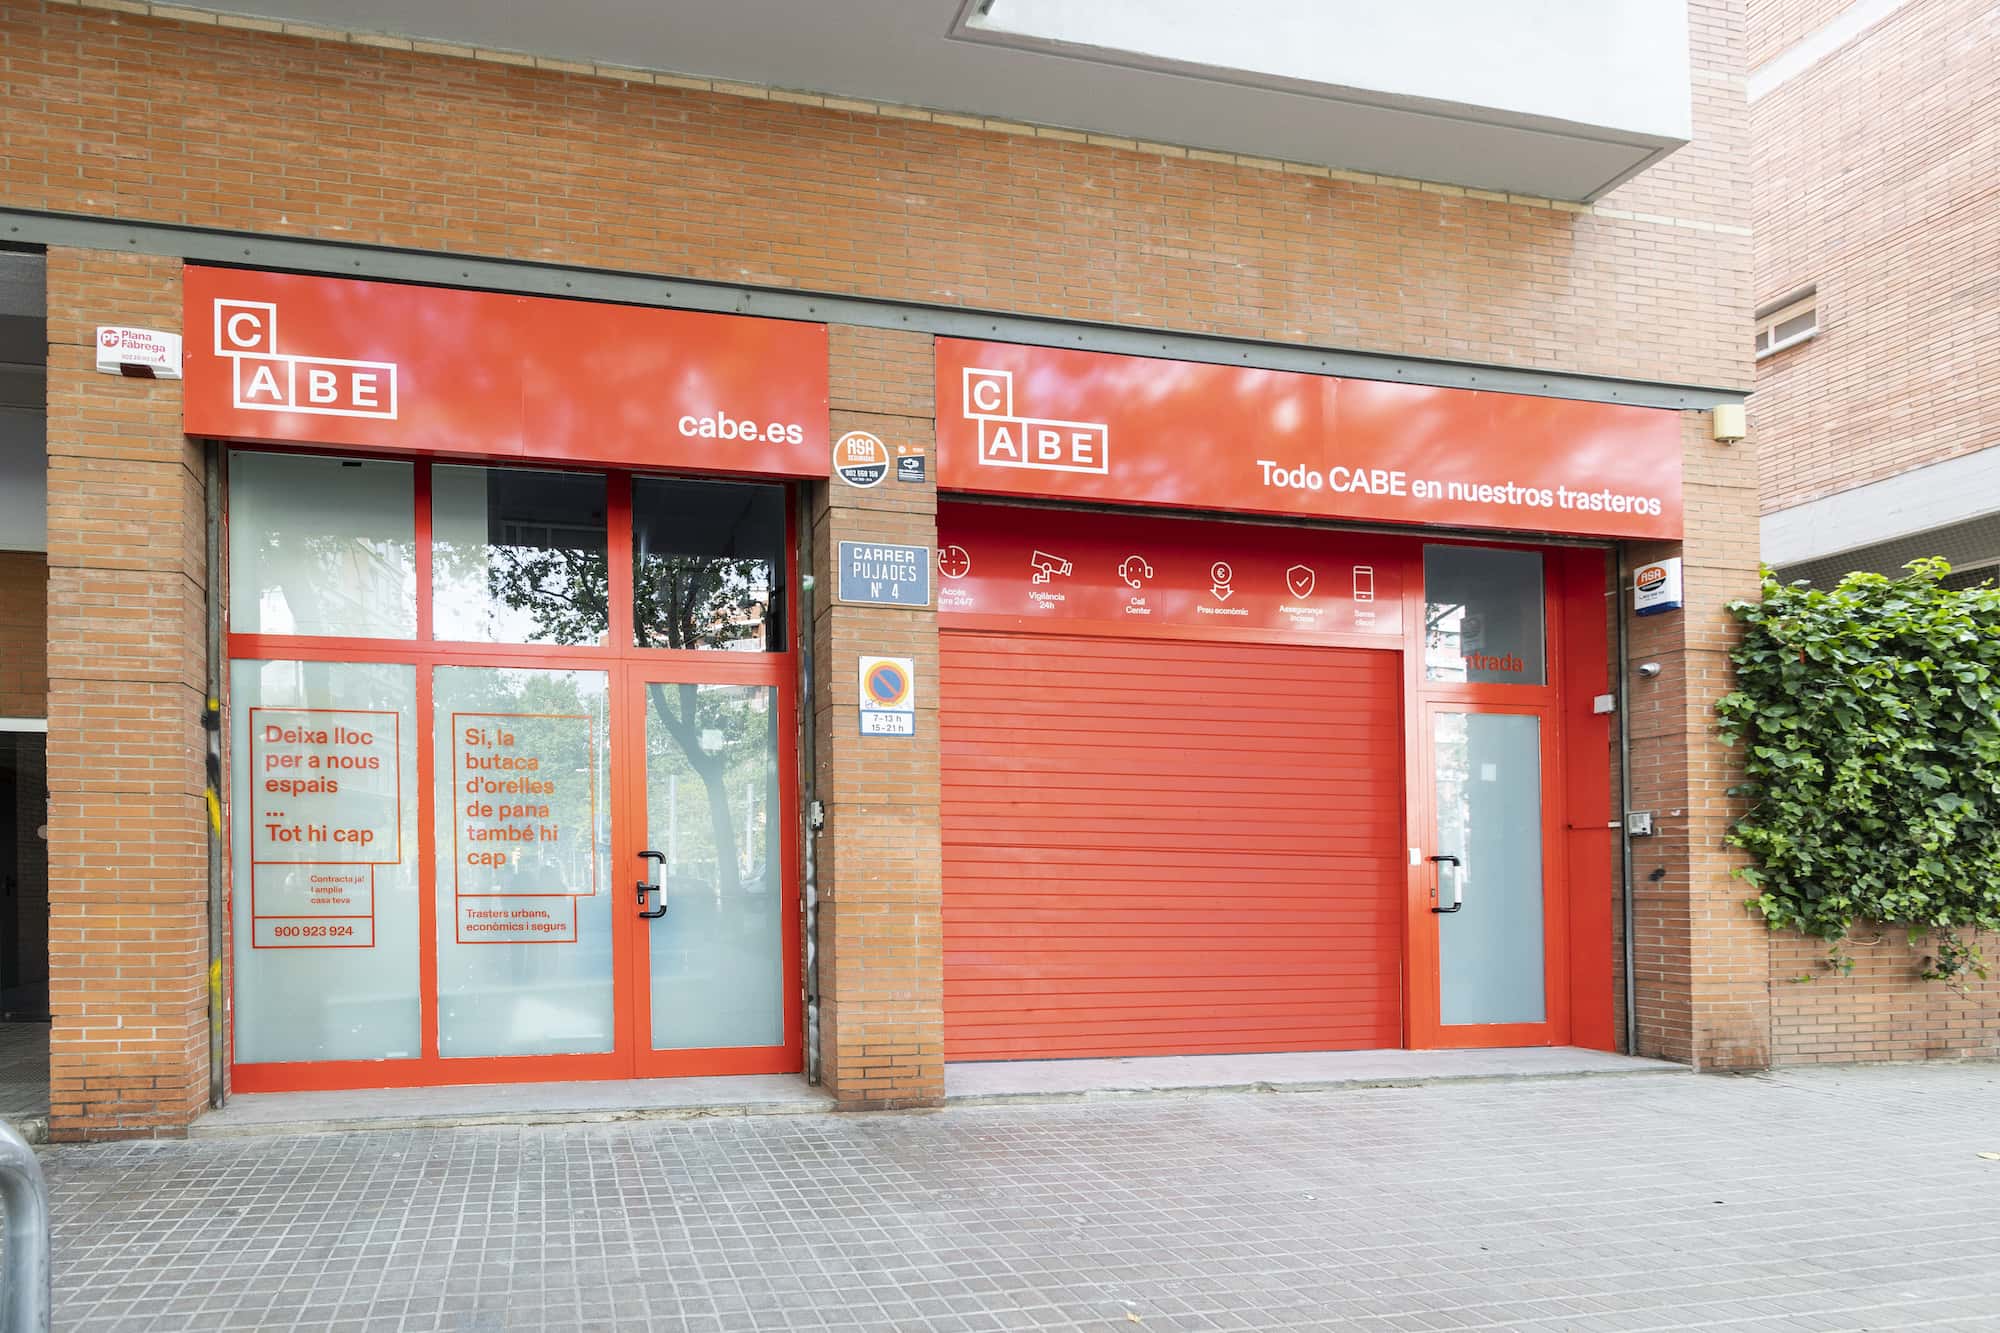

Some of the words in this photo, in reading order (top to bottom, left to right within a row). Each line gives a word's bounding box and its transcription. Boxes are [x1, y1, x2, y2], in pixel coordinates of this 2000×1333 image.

[121, 330, 152, 341] Plana
[678, 410, 803, 445] cabe.es
[1256, 459, 1323, 491] Todo
[1329, 466, 1407, 497] CABE
[1412, 479, 1442, 499] en
[1448, 481, 1553, 508] nuestros
[1556, 485, 1662, 516] trasteros
[853, 547, 915, 563] CARRER
[853, 562, 917, 582] PUJADES
[891, 583, 899, 599] 4
[1039, 601, 1055, 609] 24h
[1131, 597, 1146, 605] Call
[1197, 605, 1213, 614] Preu
[1125, 606, 1152, 615] Center
[265, 725, 328, 744] Deixa
[334, 727, 374, 745] lloc
[496, 728, 514, 746] la
[265, 754, 303, 772] per
[308, 755, 320, 769] a
[327, 755, 380, 769] nous
[465, 752, 539, 770] butaca
[265, 776, 339, 797] espais
[466, 776, 555, 794] d'orelles
[466, 800, 493, 818] de
[499, 804, 550, 821] pana
[265, 824, 302, 842] Tot
[308, 824, 327, 843] hi
[333, 828, 374, 847] cap
[467, 825, 535, 842] també
[540, 824, 558, 842] hi
[467, 852, 507, 869] cap
[310, 874, 353, 883] Contracta
[332, 896, 351, 904] teva
[465, 908, 509, 919] Trasters
[510, 908, 550, 920] urbans,
[274, 926, 300, 937] 900
[302, 926, 326, 937] 923
[329, 926, 353, 937] 924
[531, 922, 567, 933] segurs
